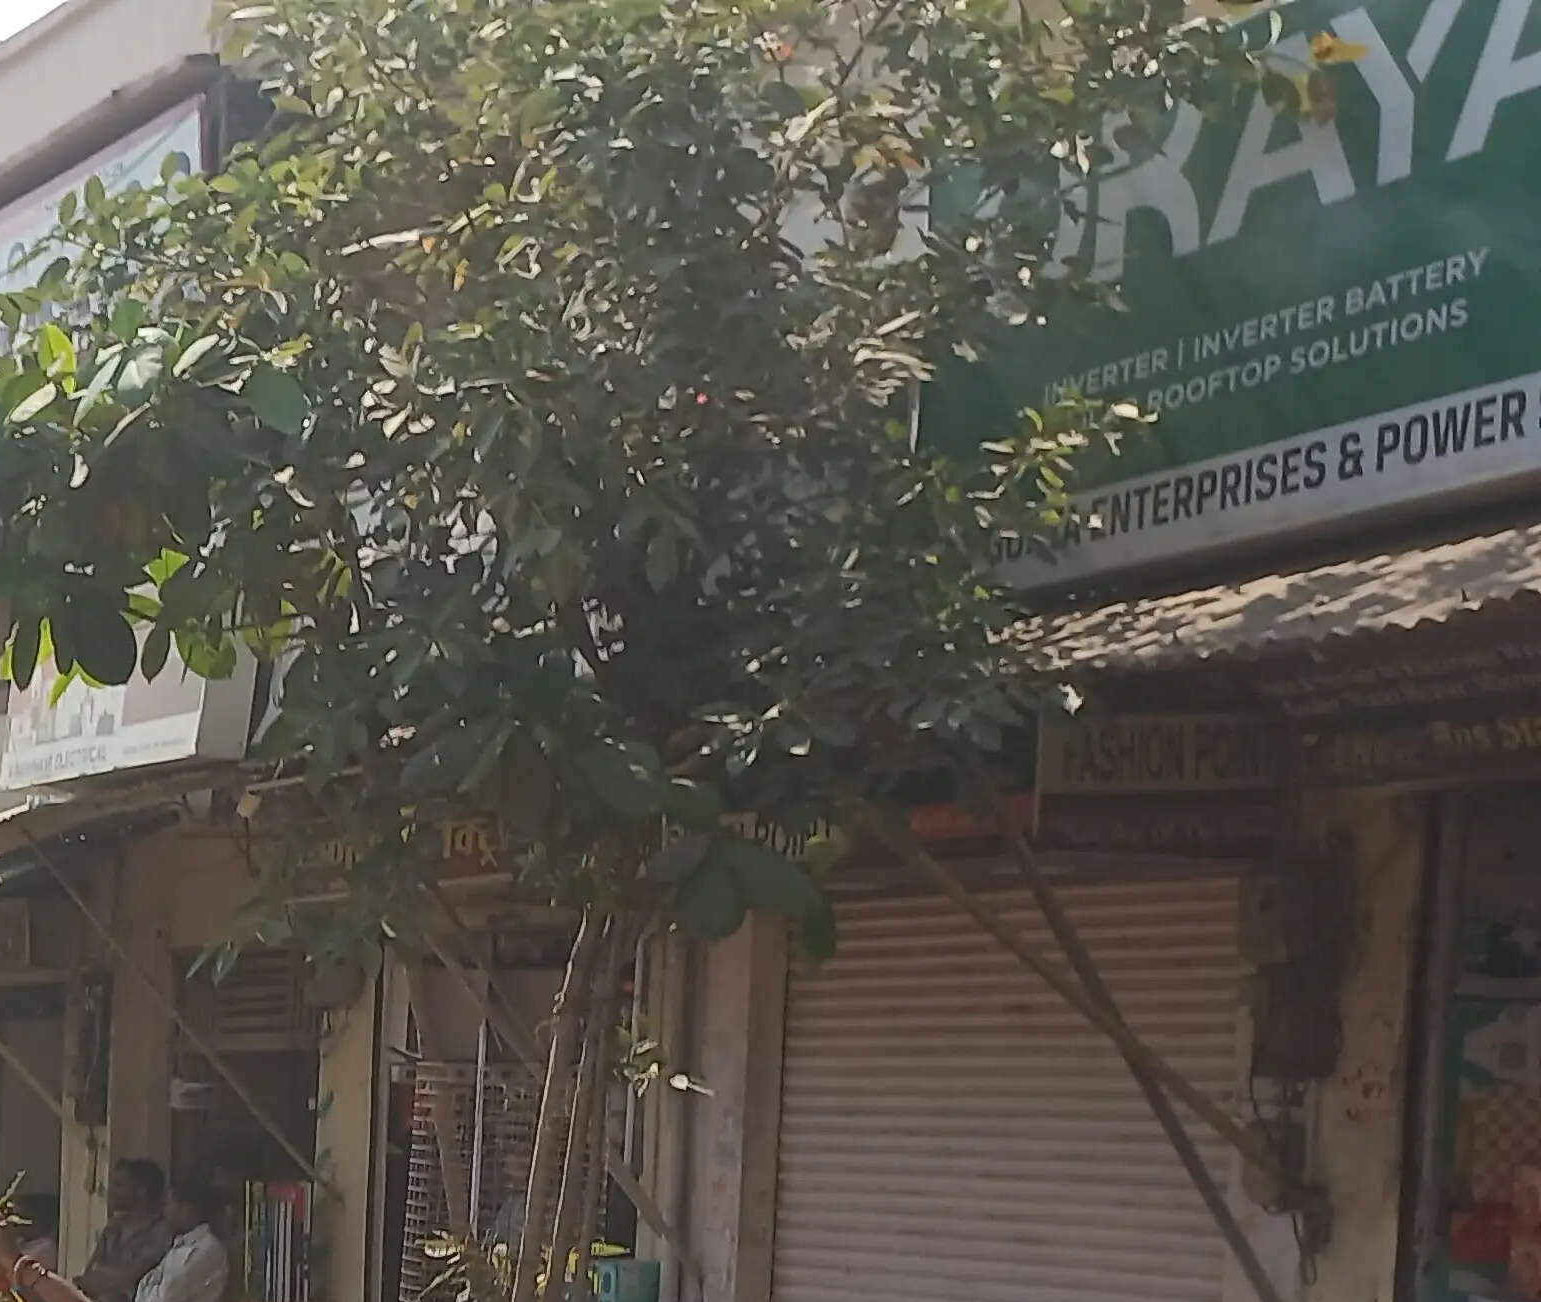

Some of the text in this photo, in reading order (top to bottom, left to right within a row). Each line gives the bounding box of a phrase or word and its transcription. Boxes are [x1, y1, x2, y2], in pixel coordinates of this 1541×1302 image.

[1041, 0, 1541, 283] RAYA
[1043, 347, 1169, 403] INVERTER
[1193, 294, 1335, 363] INVERTER
[1345, 248, 1491, 316] BATTERY
[1147, 298, 1469, 413] ROOFTOP SOLUTIONS
[1092, 441, 1326, 543] ENTERPRISES
[1338, 431, 1365, 482] &
[1375, 389, 1527, 472] POWER
